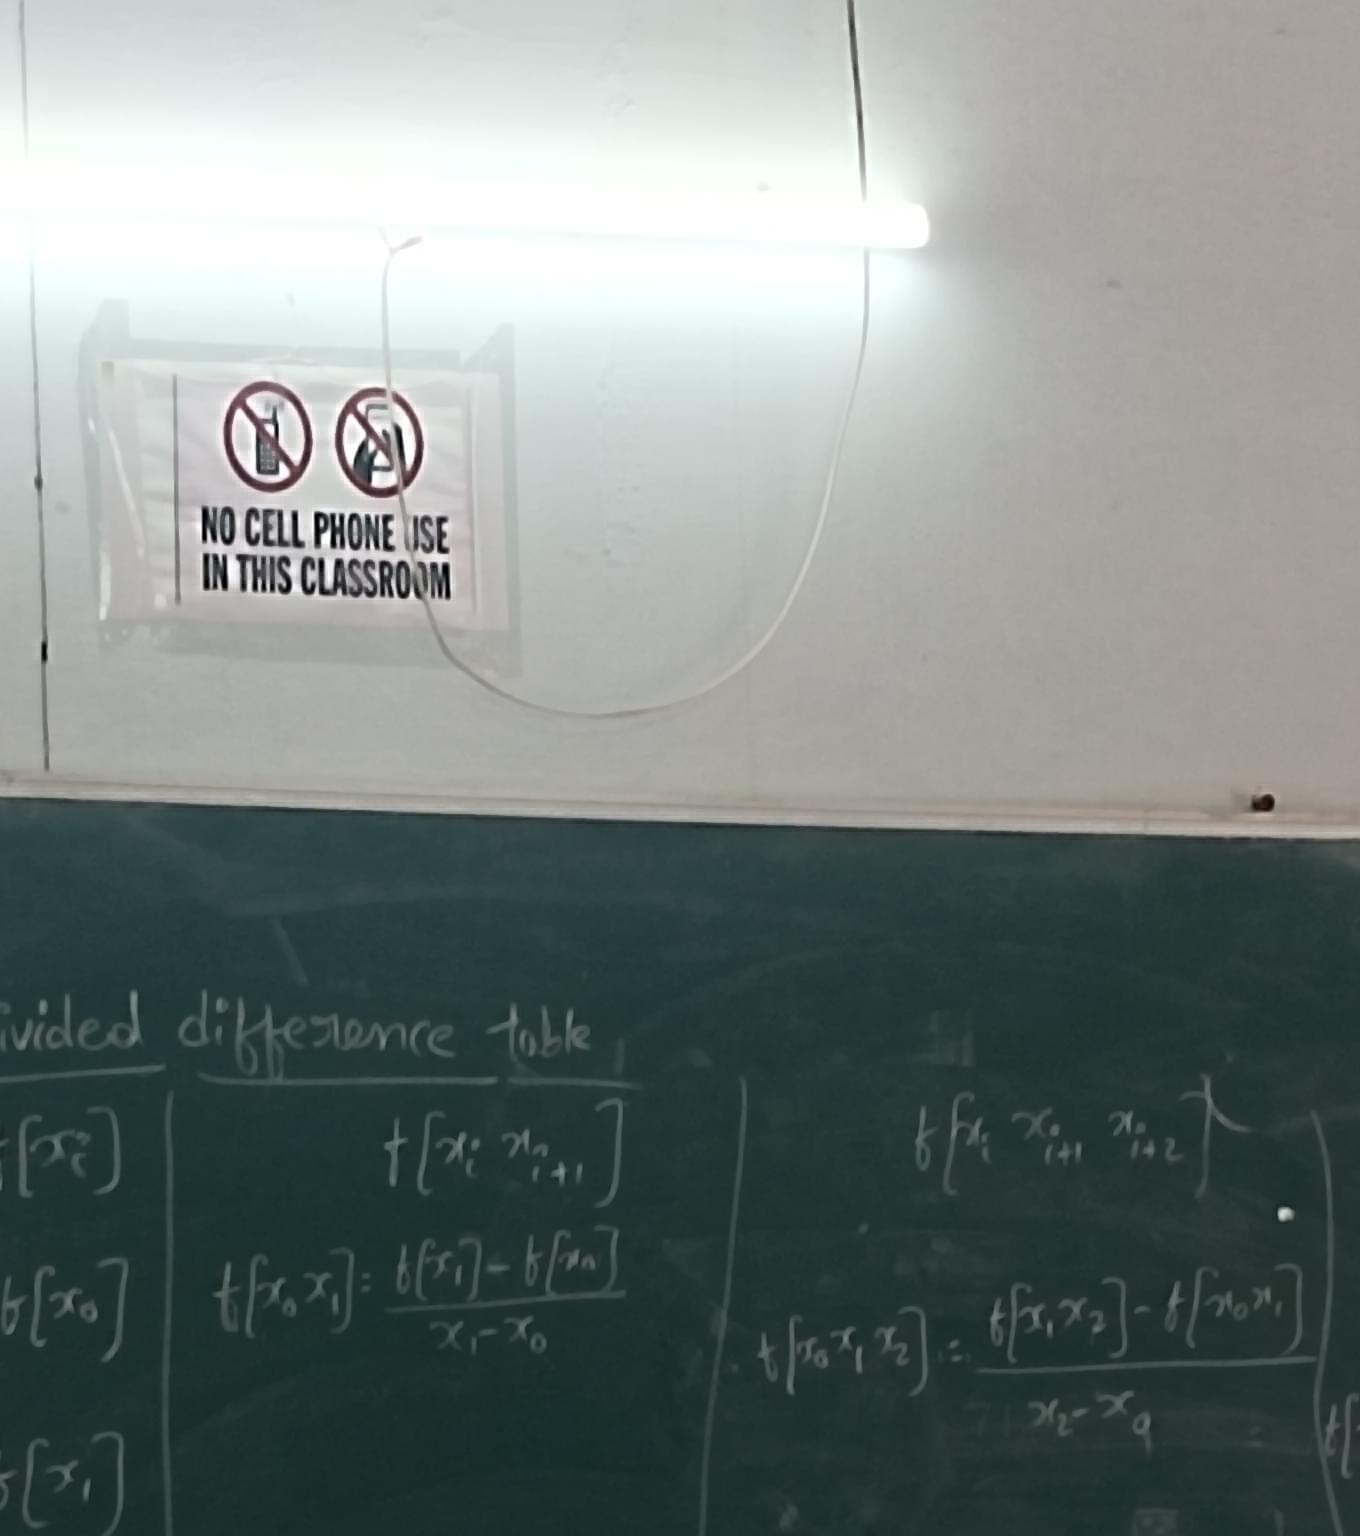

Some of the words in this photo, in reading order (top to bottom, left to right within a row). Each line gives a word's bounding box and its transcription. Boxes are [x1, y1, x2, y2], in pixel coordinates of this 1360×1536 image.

[201, 506, 236, 546] NO
[244, 508, 306, 549] CELL
[313, 511, 396, 552] PHONE
[202, 553, 229, 592] IN
[236, 554, 292, 595] THIS
[300, 558, 451, 600] CLASSROOM
[178, 990, 456, 1079] difference
